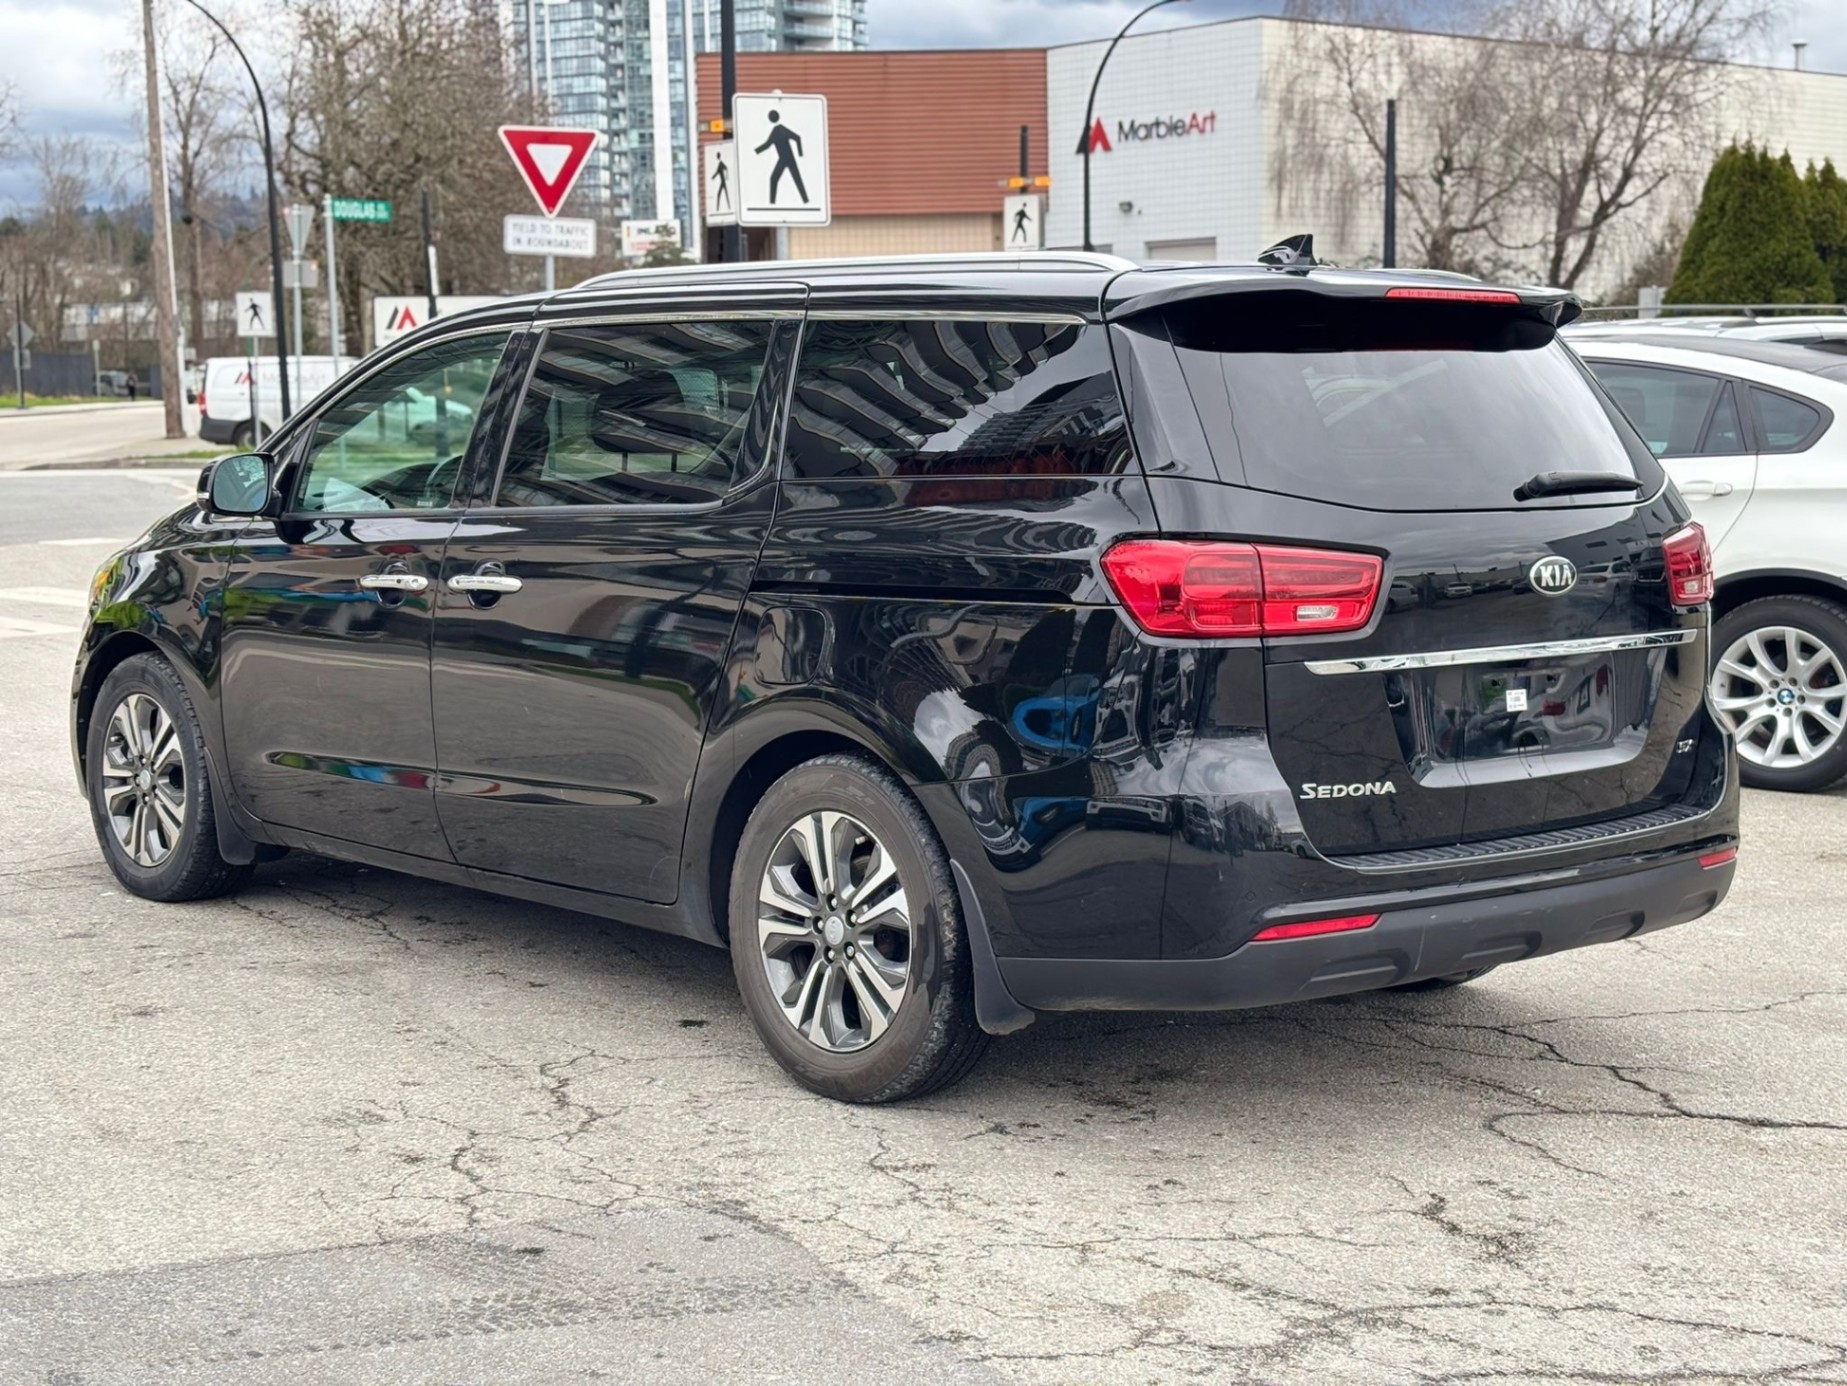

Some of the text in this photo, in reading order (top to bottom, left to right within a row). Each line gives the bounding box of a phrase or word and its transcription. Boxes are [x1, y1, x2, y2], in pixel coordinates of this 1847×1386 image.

[1118, 110, 1216, 142] MarbleArt
[334, 201, 375, 219] DOUGLAS
[512, 223, 589, 237] YIELD TO TRAFFIC
[512, 236, 588, 250] IN ROUNDABOUT
[1539, 564, 1572, 587] KIA
[1300, 781, 1397, 799] SEDONA
